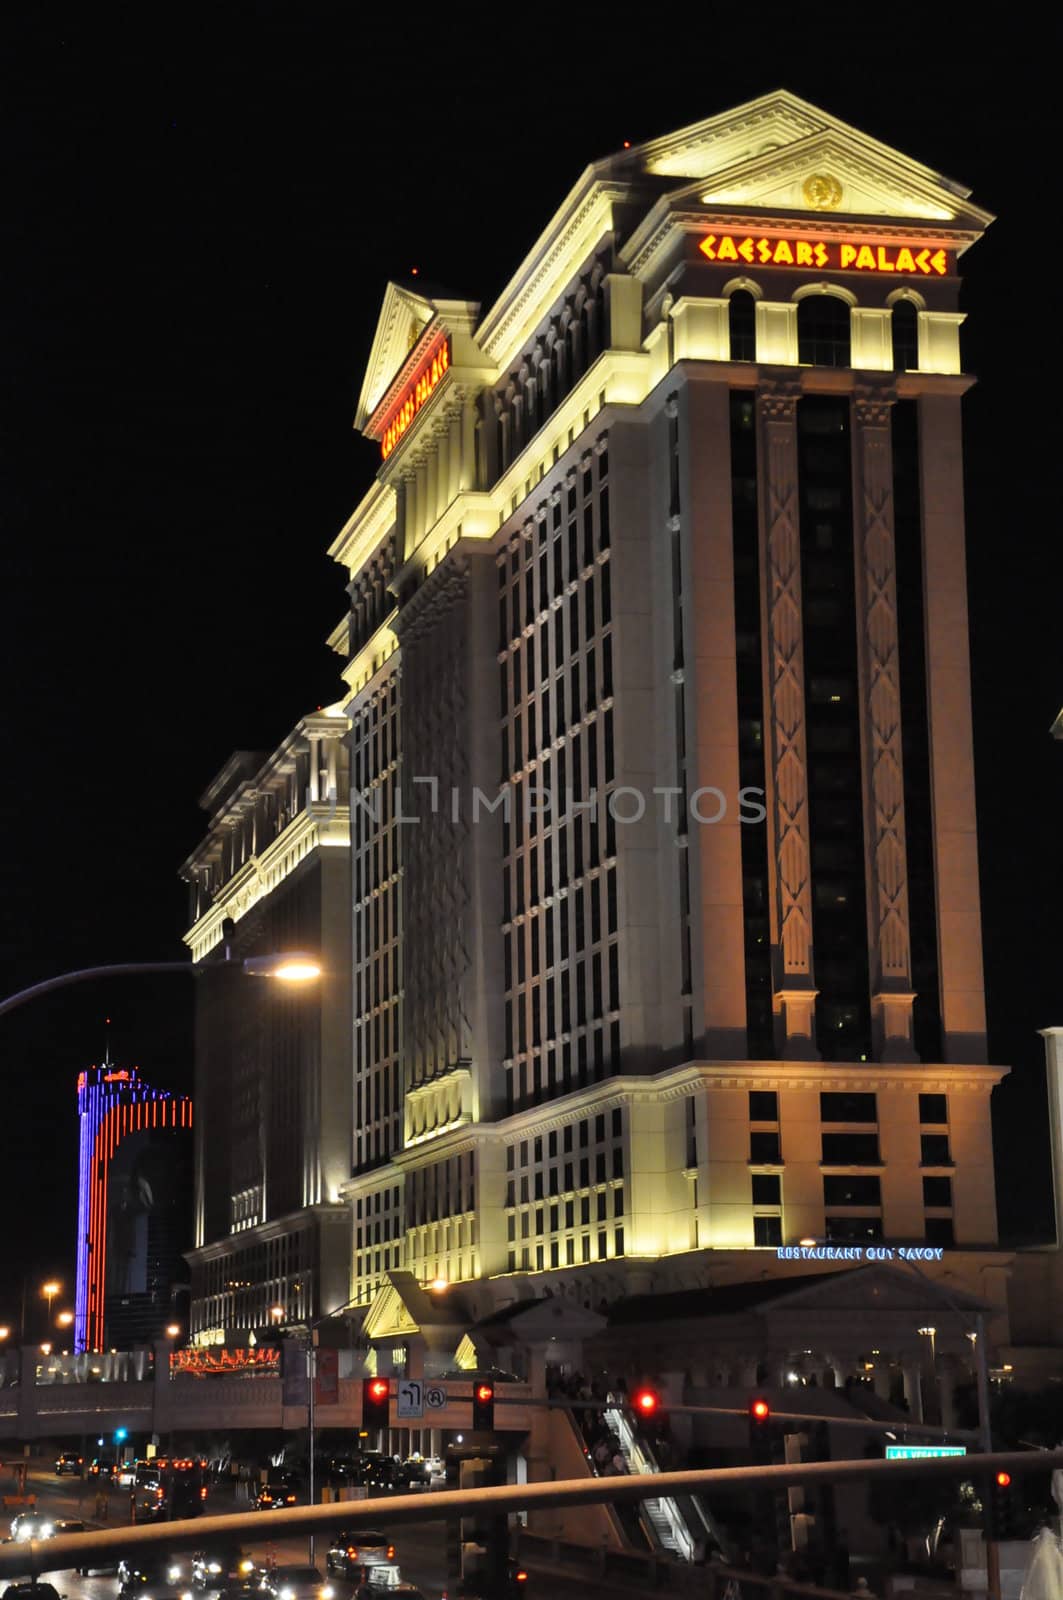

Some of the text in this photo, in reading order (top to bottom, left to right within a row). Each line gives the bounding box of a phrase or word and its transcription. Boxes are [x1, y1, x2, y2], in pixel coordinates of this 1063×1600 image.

[699, 234, 947, 276] CAESARS PALACE
[777, 1246, 944, 1261] RESTAURANT GUY SAVOY
